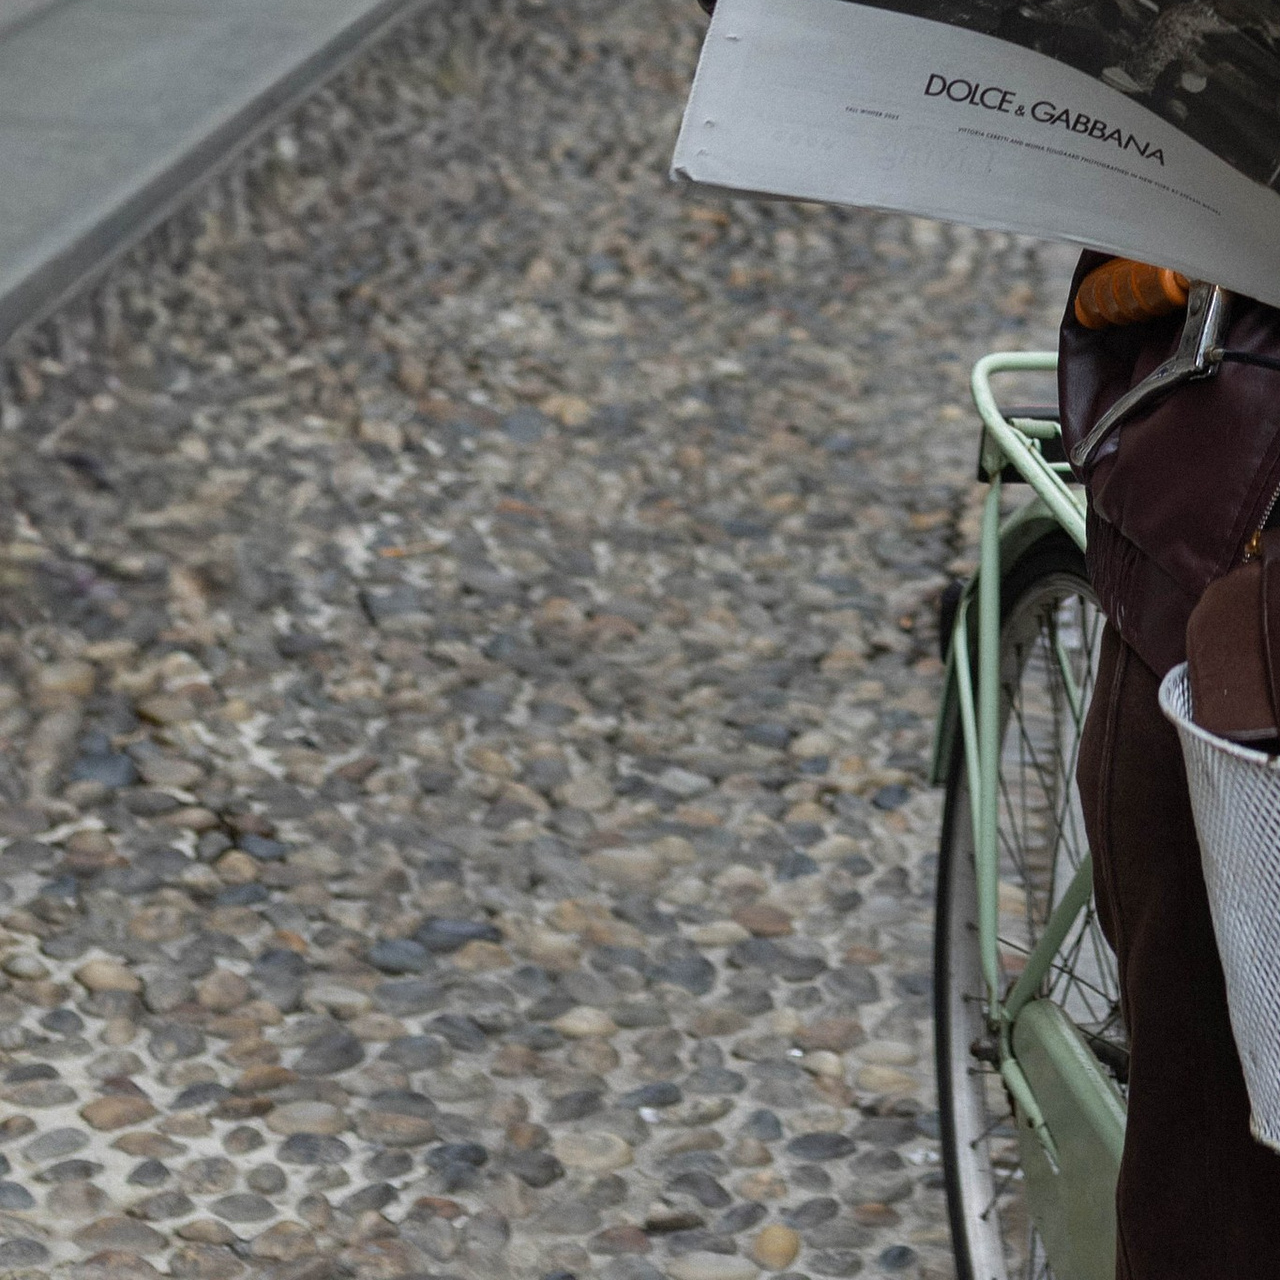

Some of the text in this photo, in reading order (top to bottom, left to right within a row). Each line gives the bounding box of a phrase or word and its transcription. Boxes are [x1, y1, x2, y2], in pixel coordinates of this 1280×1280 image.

[924, 73, 1165, 167] DOLCE & GABBANA
